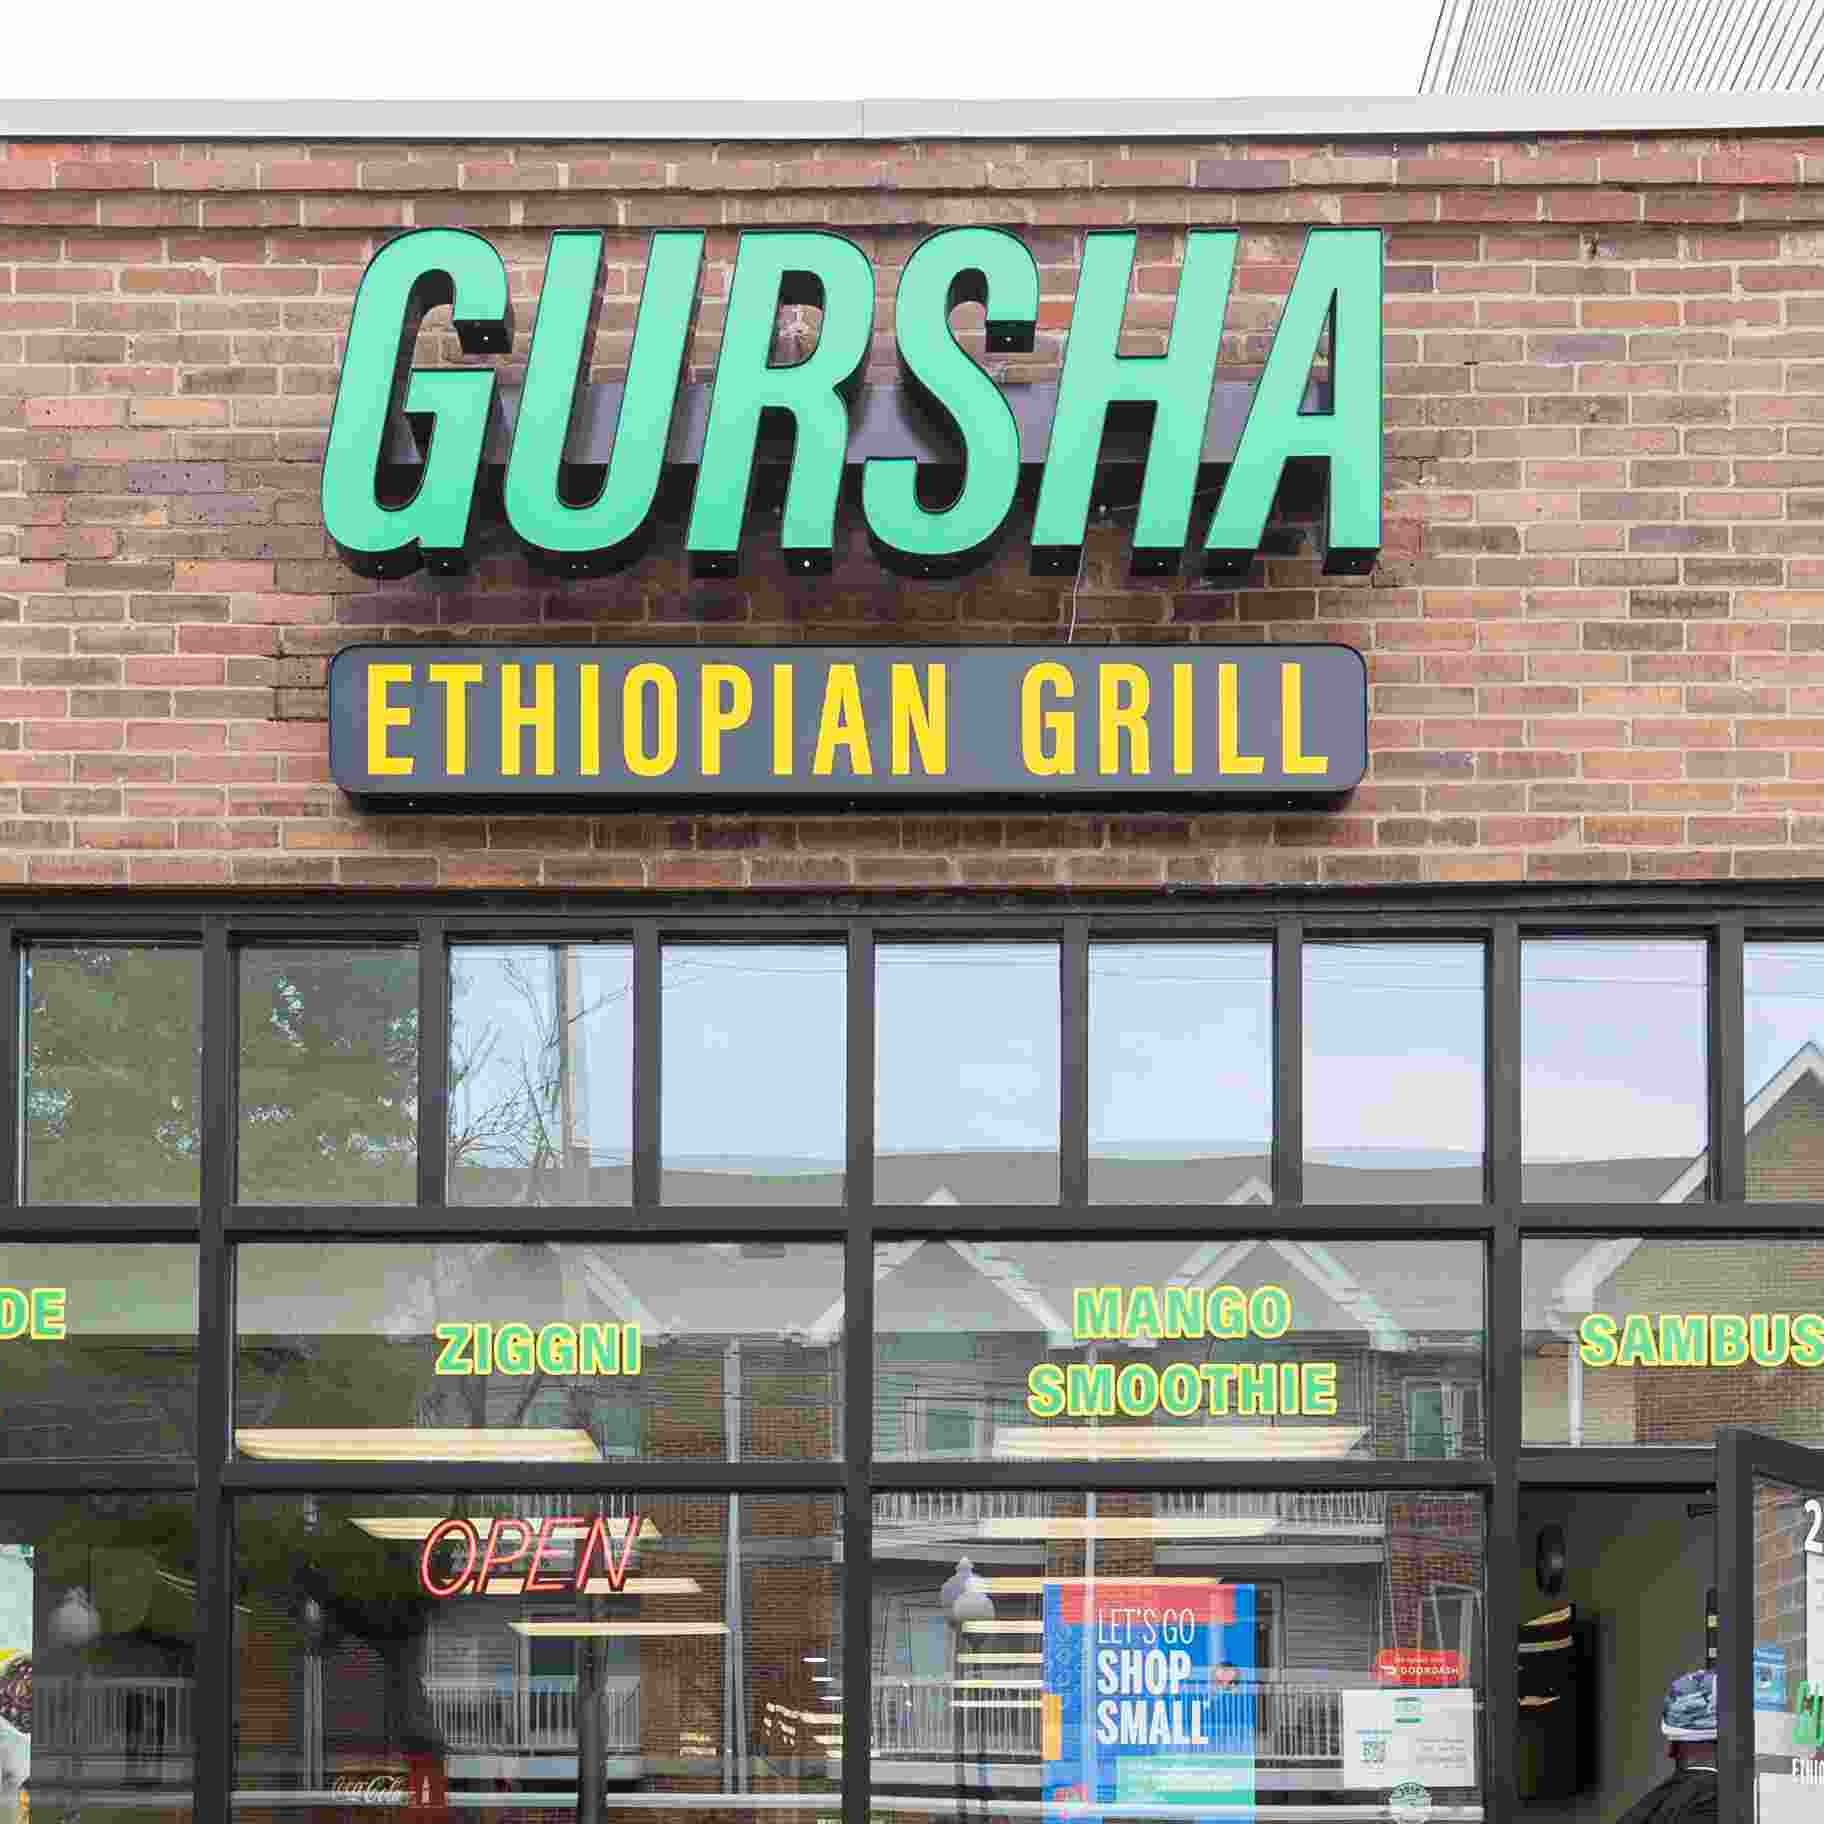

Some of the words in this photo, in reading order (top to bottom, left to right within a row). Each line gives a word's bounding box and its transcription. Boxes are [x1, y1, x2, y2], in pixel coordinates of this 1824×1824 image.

[321, 225, 1386, 568] GURSHA
[366, 661, 948, 777] ETHIOPIAN
[1020, 661, 1331, 777] GRILL
[1072, 1285, 1293, 1339] MANGO
[433, 1321, 642, 1376] ZIGGNI
[1026, 1362, 1338, 1417] SMOOTHIE
[419, 1516, 641, 1596] OPEN
[1097, 1608, 1157, 1645] LET'S
[1162, 1608, 1196, 1645] GO
[1096, 1649, 1192, 1696] SHOP
[1096, 1699, 1209, 1745] SMALL
